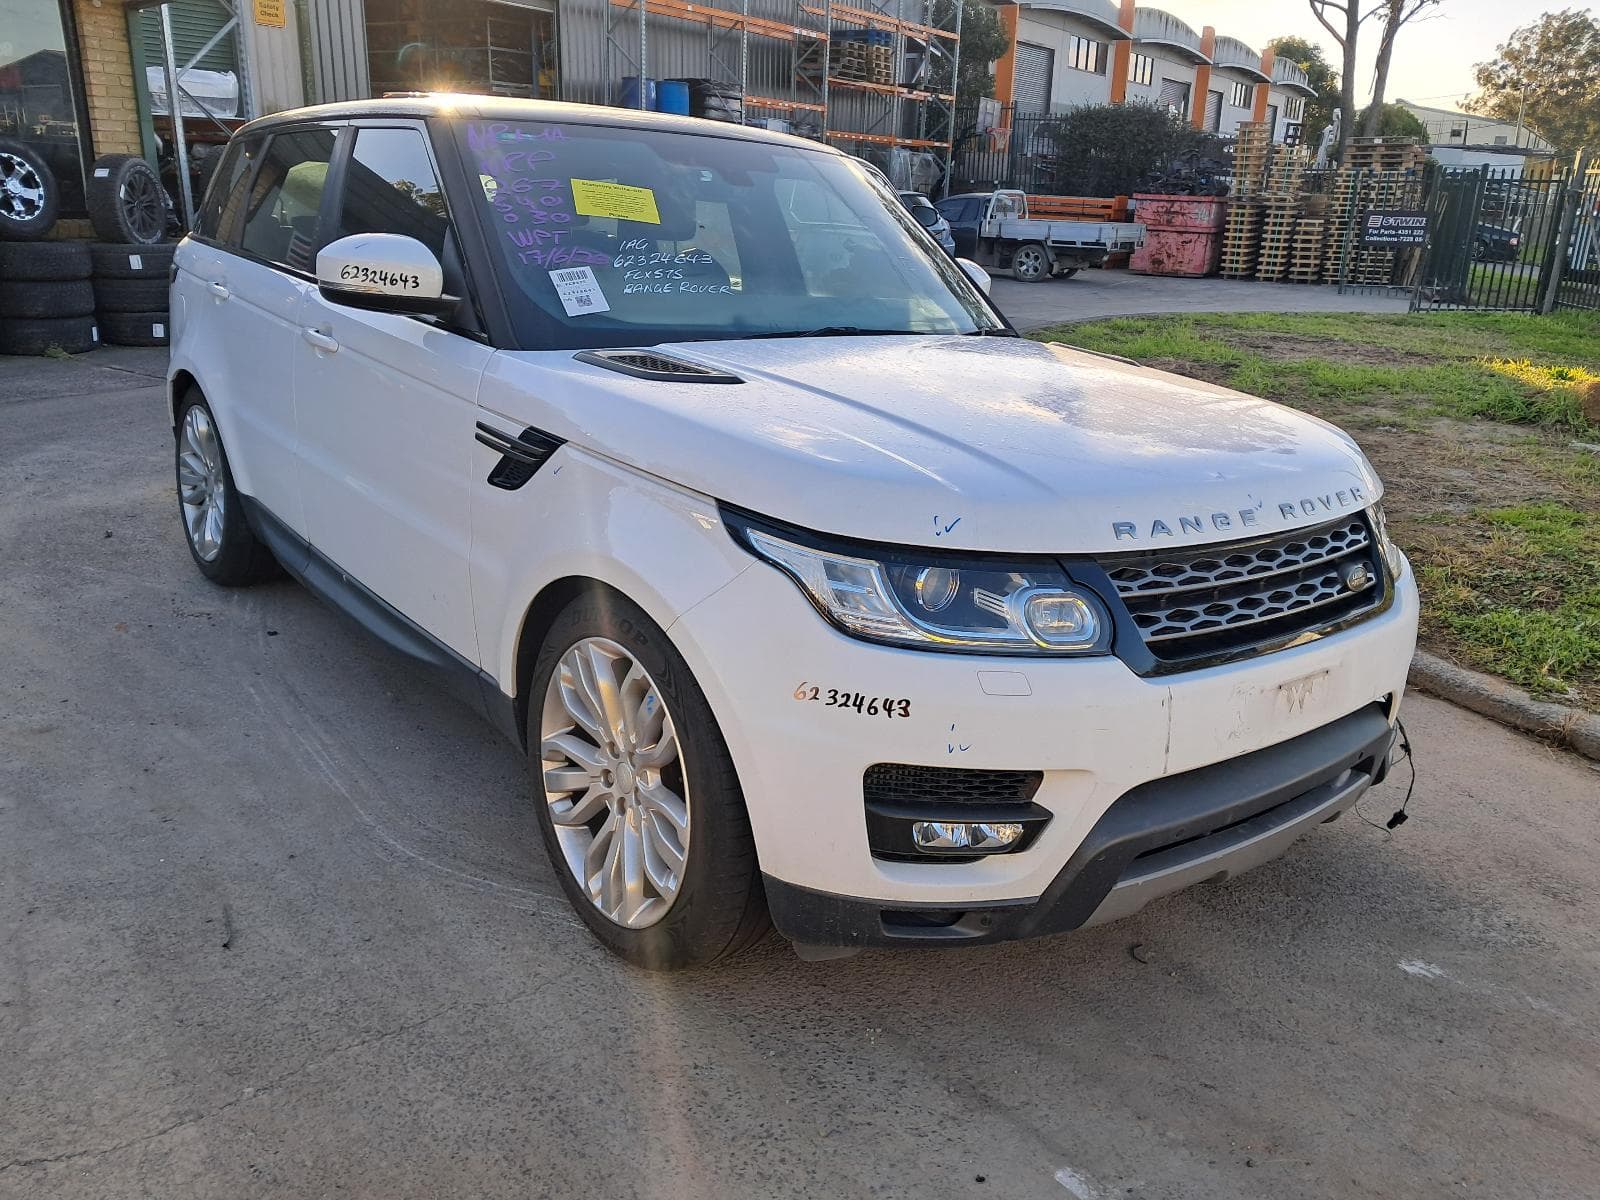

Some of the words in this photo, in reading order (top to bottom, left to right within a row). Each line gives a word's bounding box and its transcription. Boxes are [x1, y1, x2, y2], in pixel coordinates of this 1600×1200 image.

[613, 252, 713, 268] 62324643
[340, 264, 420, 289] 62324643
[623, 283, 673, 294] RANGE
[679, 281, 735, 295] ROVER
[1112, 508, 1260, 541] RANGE
[1278, 486, 1365, 520] ROVER
[793, 682, 911, 718] 62324643
